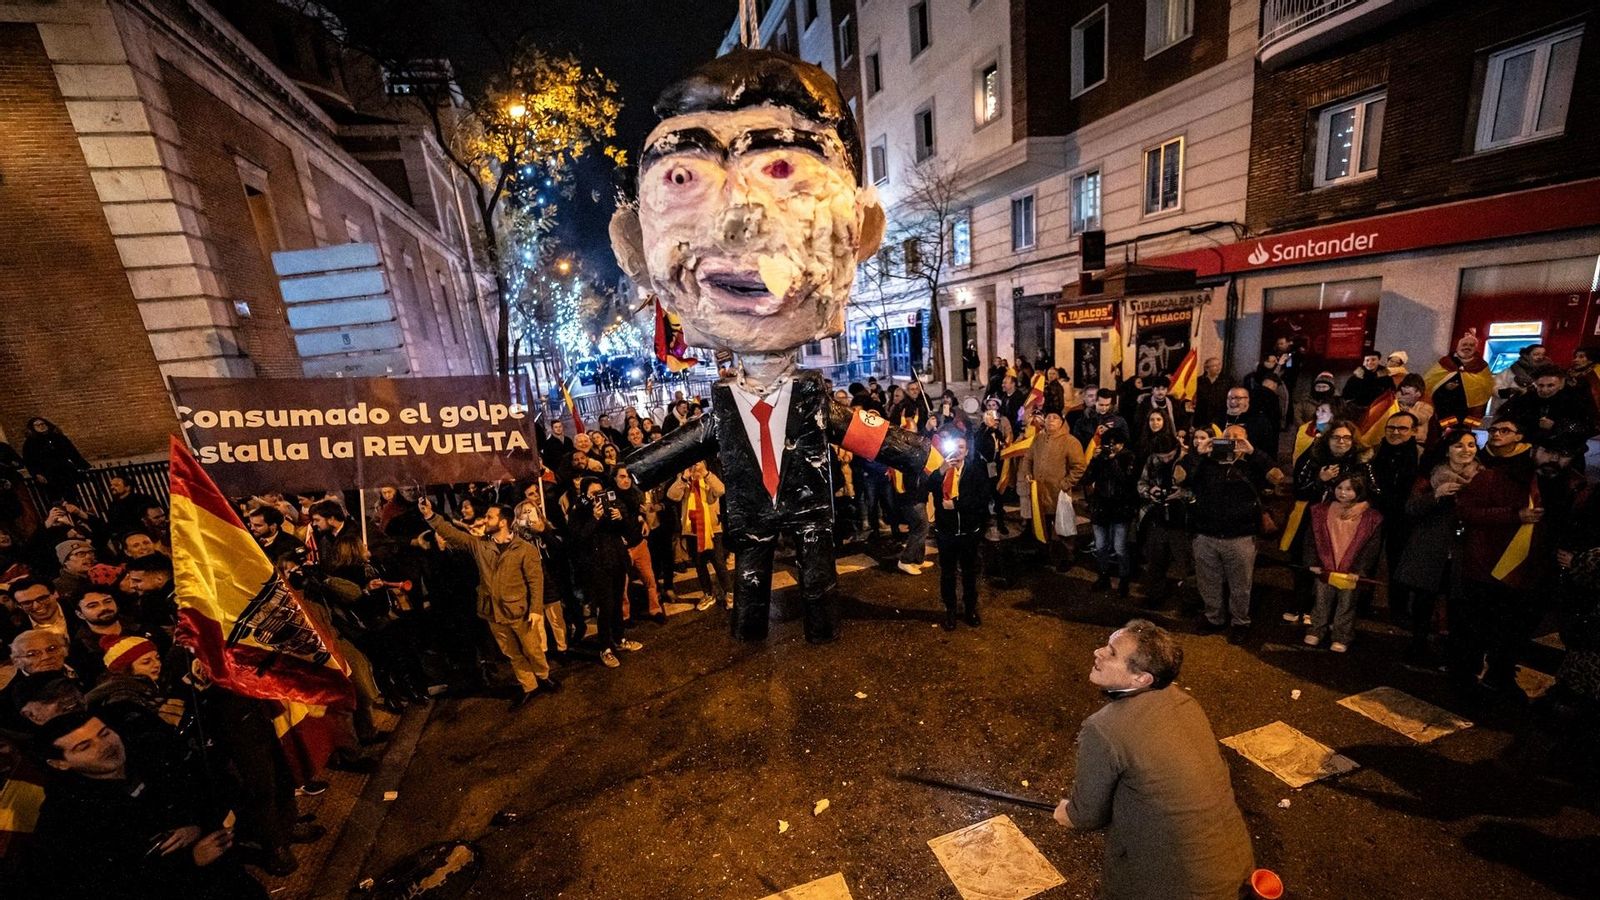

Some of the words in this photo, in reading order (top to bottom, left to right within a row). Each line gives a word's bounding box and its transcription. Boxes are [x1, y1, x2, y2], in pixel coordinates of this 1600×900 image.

[1272, 232, 1379, 262] Santander
[1068, 307, 1108, 321] TABACOS
[1150, 311, 1192, 324] TABACOS
[399, 402, 431, 424] el
[439, 400, 526, 428] golpe
[191, 438, 310, 464] stalla
[319, 436, 354, 459] la
[363, 430, 530, 457] REVUELTA
